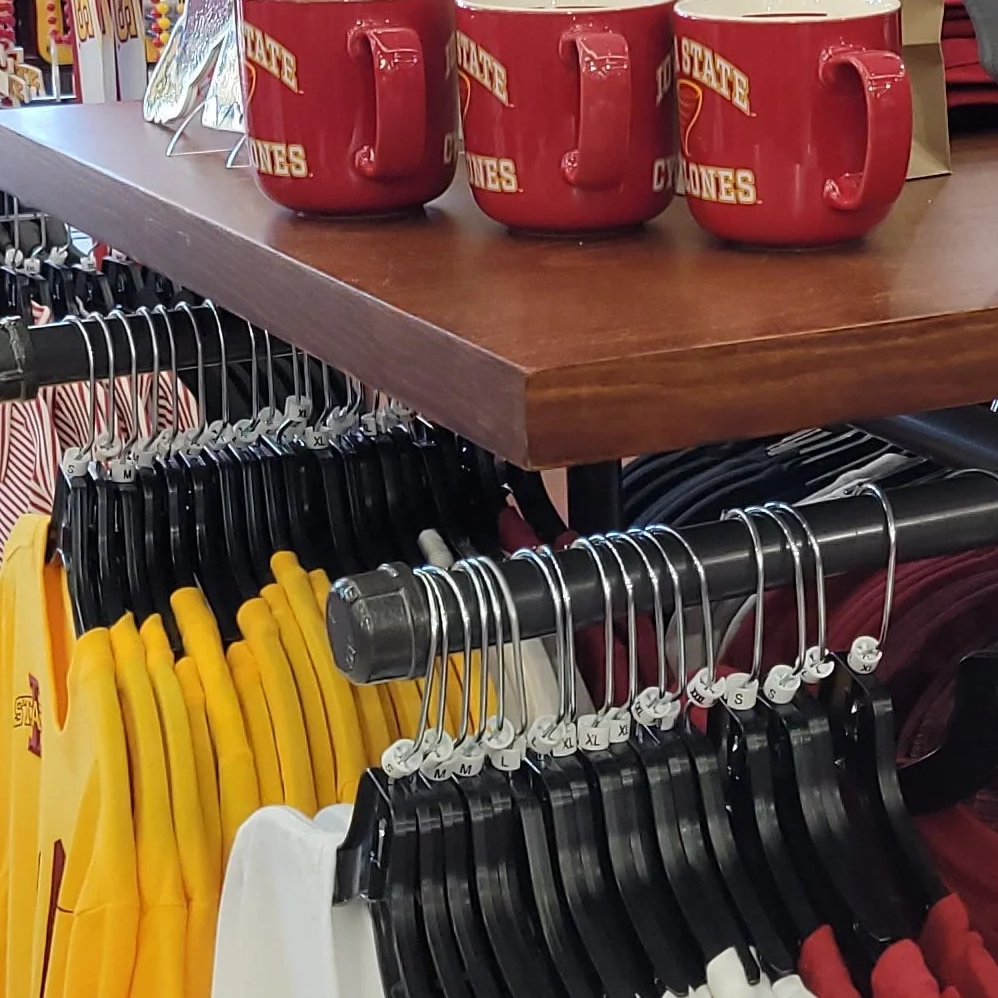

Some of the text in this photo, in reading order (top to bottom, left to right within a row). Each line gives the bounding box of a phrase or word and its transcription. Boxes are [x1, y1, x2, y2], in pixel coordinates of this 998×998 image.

[243, 21, 300, 93] TATE
[456, 30, 509, 107] TATE
[681, 36, 751, 117] STATE
[313, 436, 326, 447] XL
[733, 692, 744, 705] S
[585, 733, 601, 747] XL
[434, 768, 447, 780] M
[460, 763, 473, 775] M
